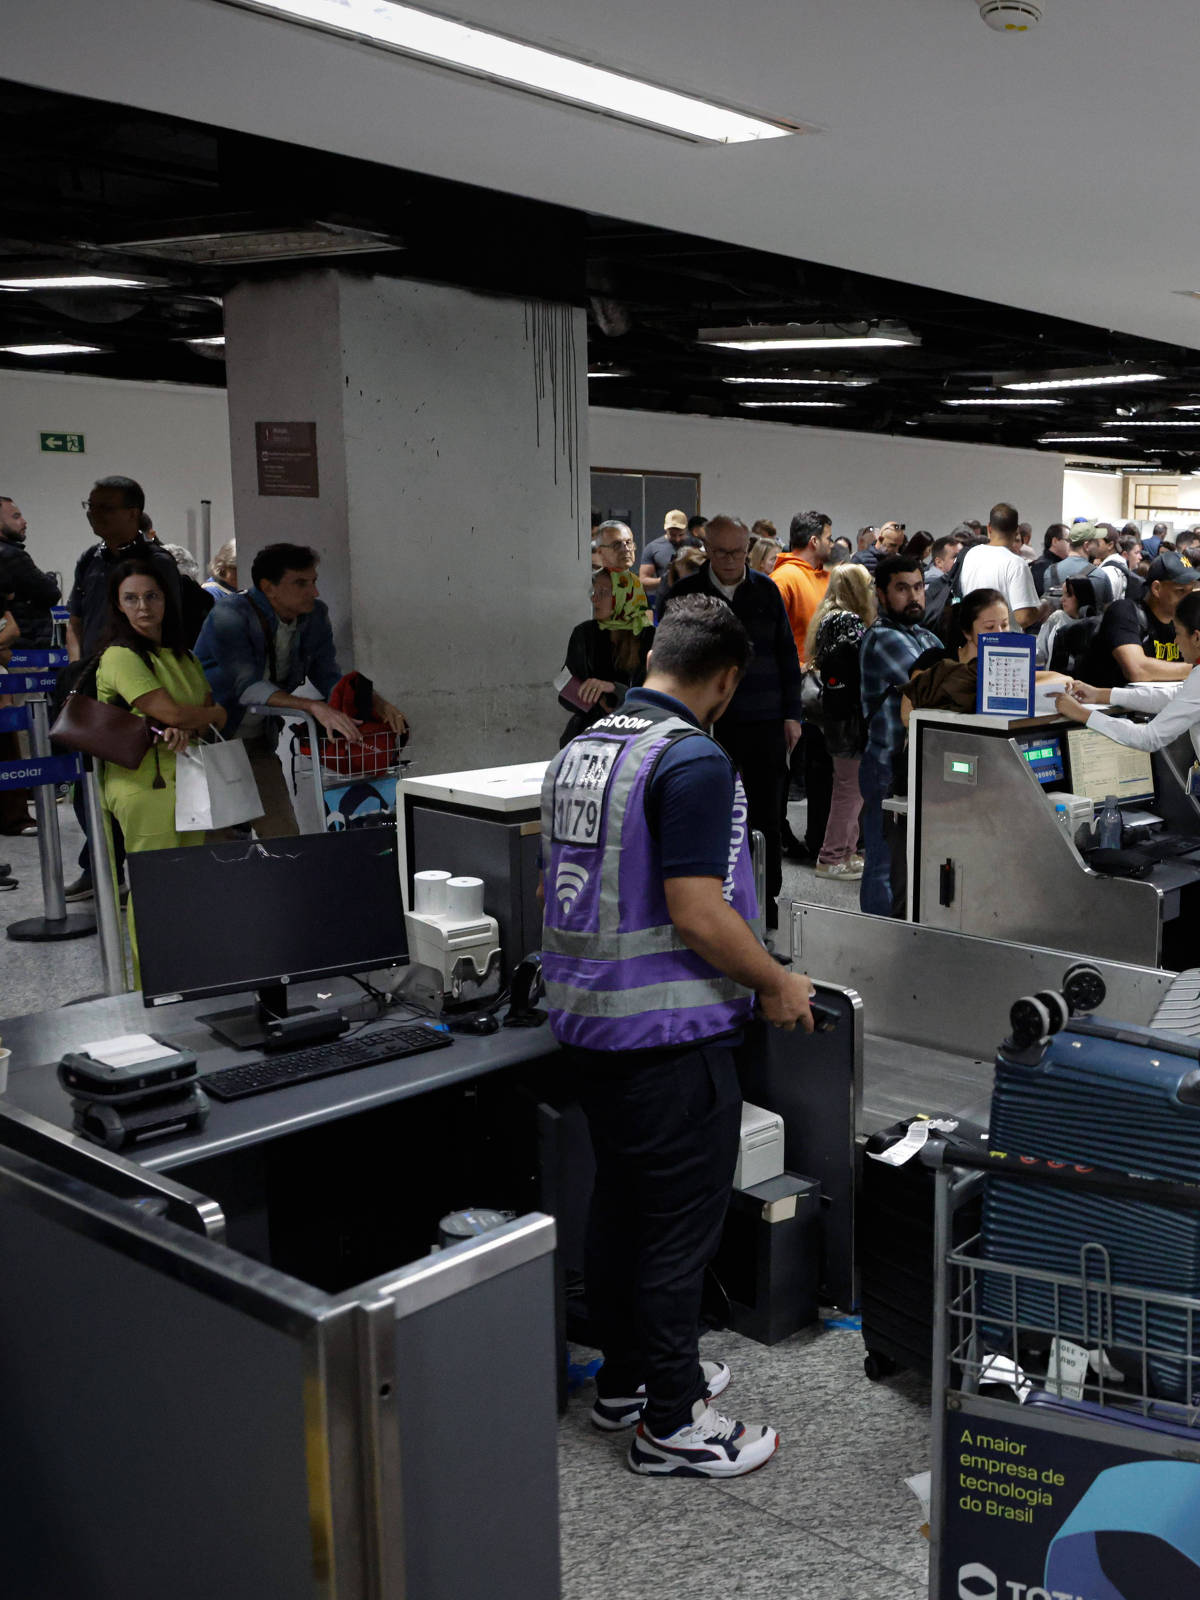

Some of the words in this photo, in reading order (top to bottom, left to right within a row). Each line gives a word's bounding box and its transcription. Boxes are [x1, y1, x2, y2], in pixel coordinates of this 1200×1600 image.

[0, 768, 42, 781] ecolar
[960, 1429, 973, 1445] A
[976, 1435, 1027, 1456] maior
[960, 1453, 1038, 1480] empresa
[1041, 1468, 1065, 1486] de
[959, 1472, 1053, 1506] tecnologia
[959, 1495, 982, 1512] do
[986, 1500, 1033, 1523] Brasil
